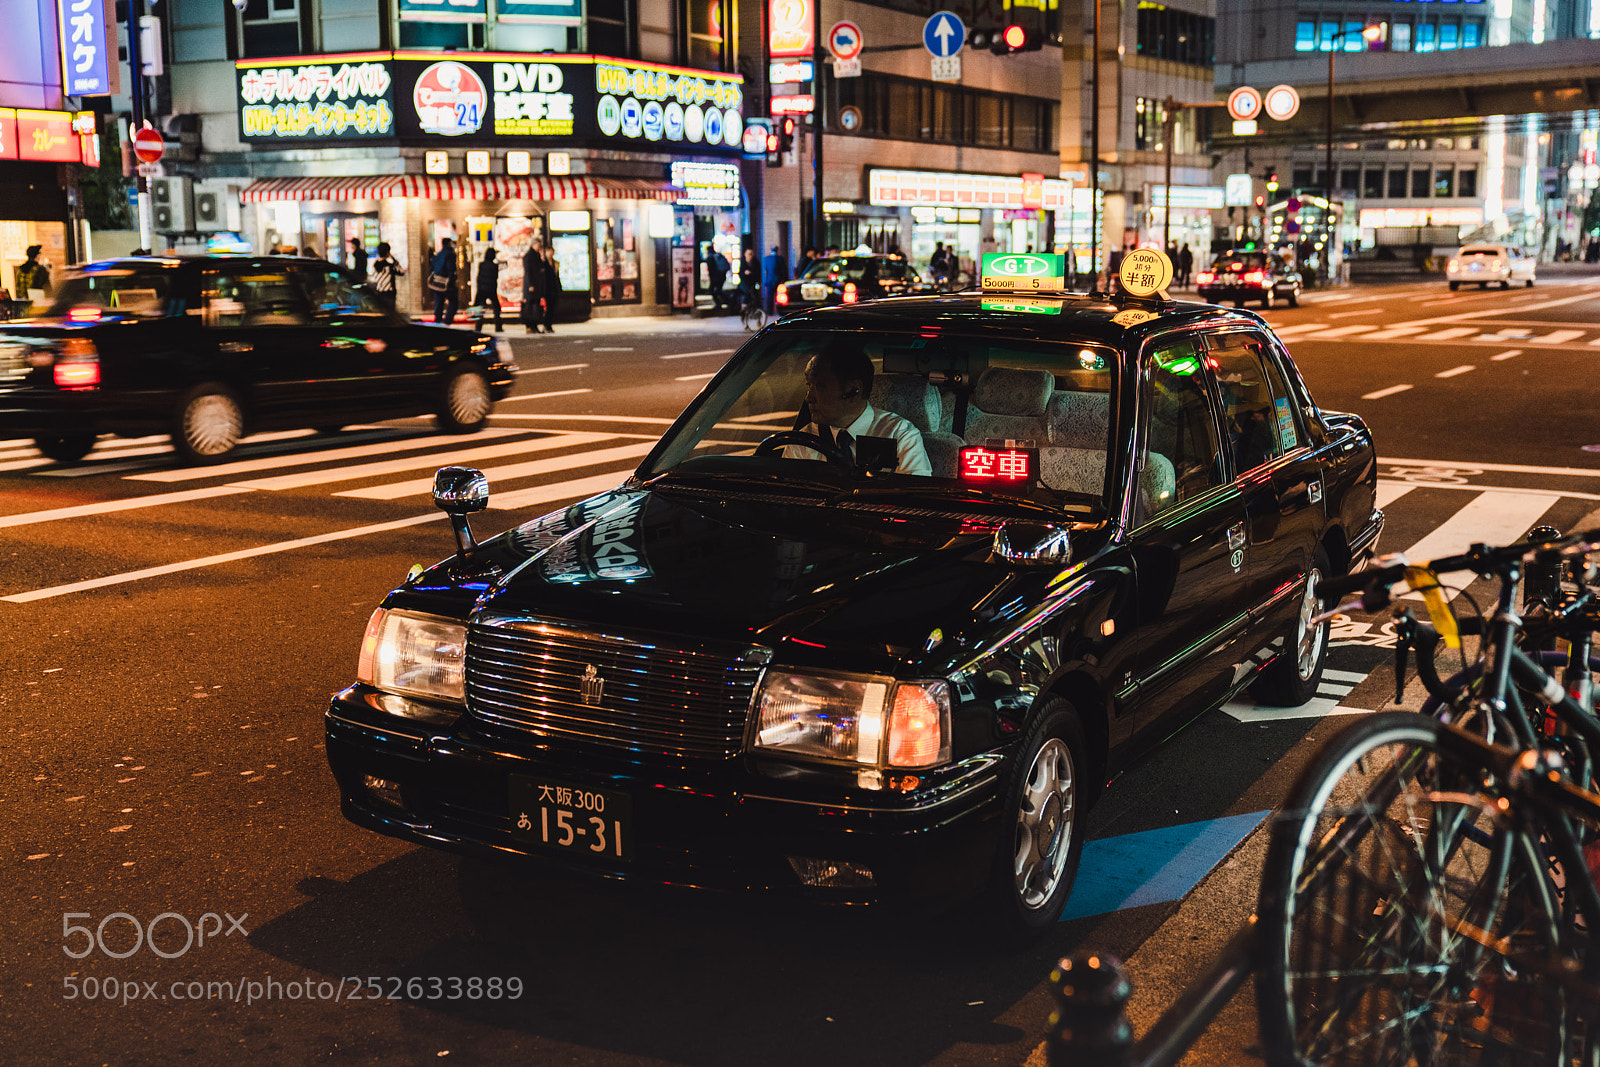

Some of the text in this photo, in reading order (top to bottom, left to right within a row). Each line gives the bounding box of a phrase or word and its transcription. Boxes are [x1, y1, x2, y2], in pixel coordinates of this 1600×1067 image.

[241, 62, 391, 104] ホテルがライバル
[494, 63, 563, 92] DVD
[32, 128, 67, 152] カレー
[1125, 271, 1156, 289] 半額
[964, 448, 1029, 480] 空車
[517, 807, 622, 857] あ 15-31
